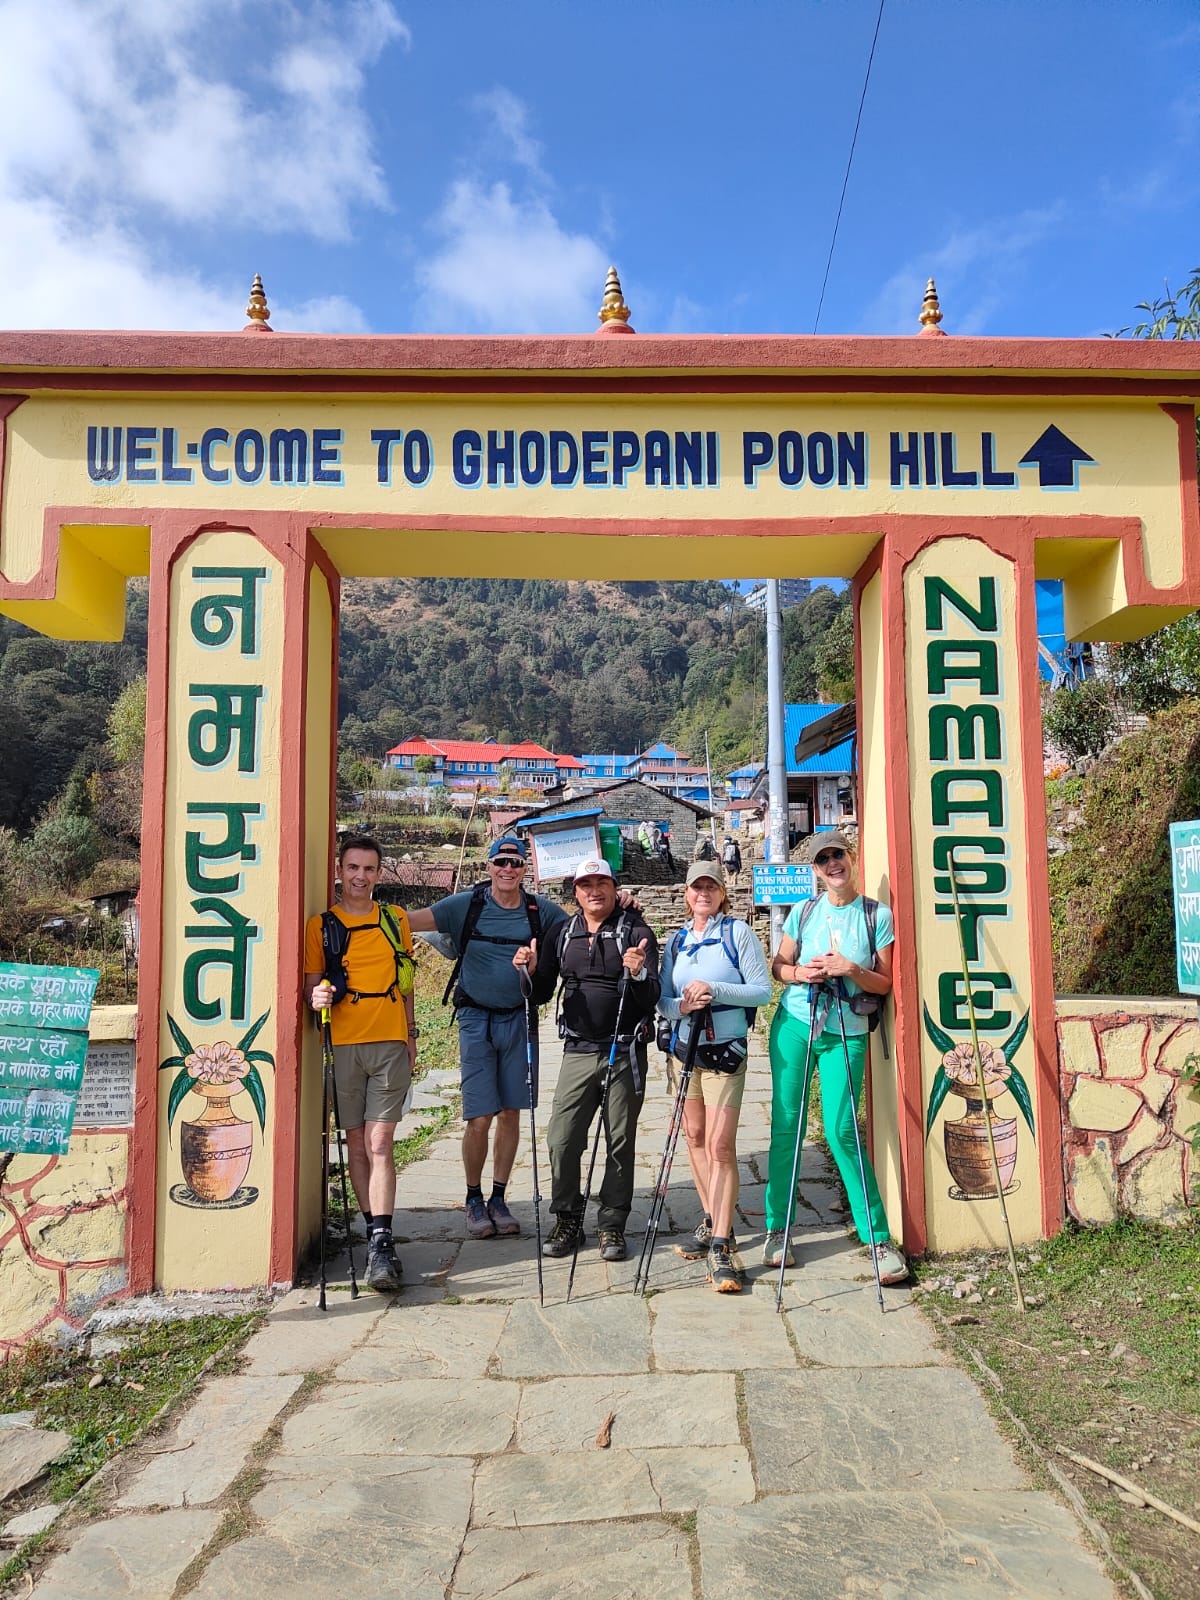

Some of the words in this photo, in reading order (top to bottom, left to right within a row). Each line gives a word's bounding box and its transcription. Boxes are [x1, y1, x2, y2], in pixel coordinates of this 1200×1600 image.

[88, 426, 342, 482] WEL-COME
[371, 429, 431, 485] TO
[453, 430, 717, 485] GHODEPANI
[743, 431, 865, 485] POON
[890, 432, 1015, 485] HILL
[924, 576, 1012, 1031] NAMASTE
[756, 886, 785, 895] CHECK
[786, 886, 811, 894] POINT
